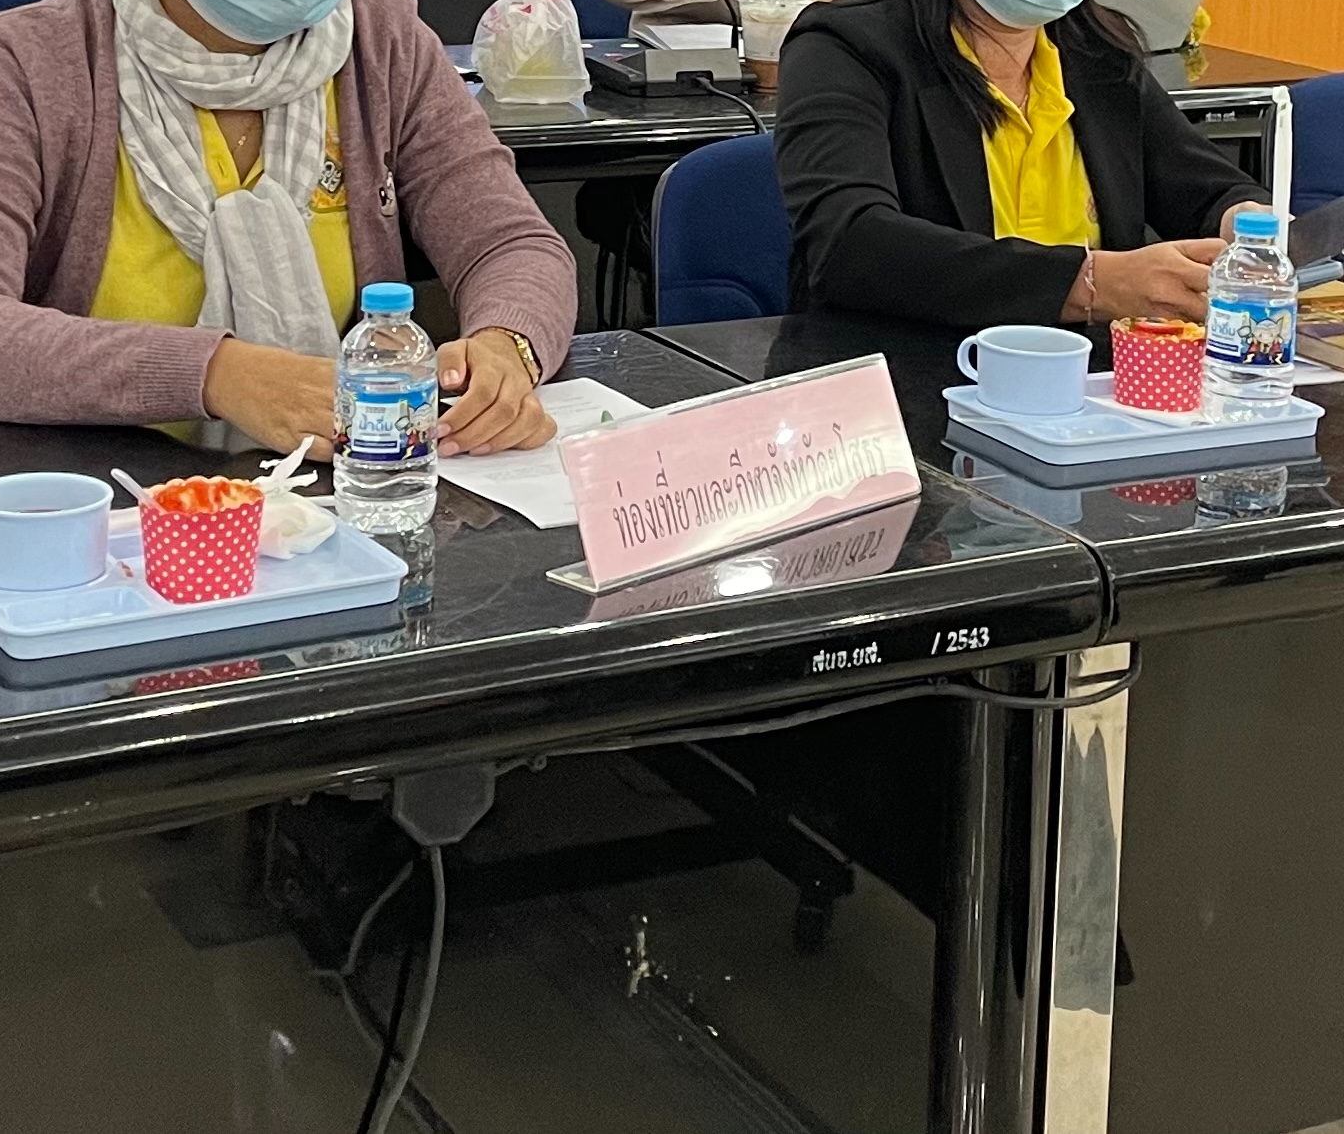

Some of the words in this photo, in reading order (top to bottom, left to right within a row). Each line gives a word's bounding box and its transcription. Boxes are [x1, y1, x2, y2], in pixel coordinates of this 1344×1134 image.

[612, 421, 887, 549] ท่องเที่ยวและกีฬาจังหวัดยโสธร
[945, 626, 991, 654] 2543
